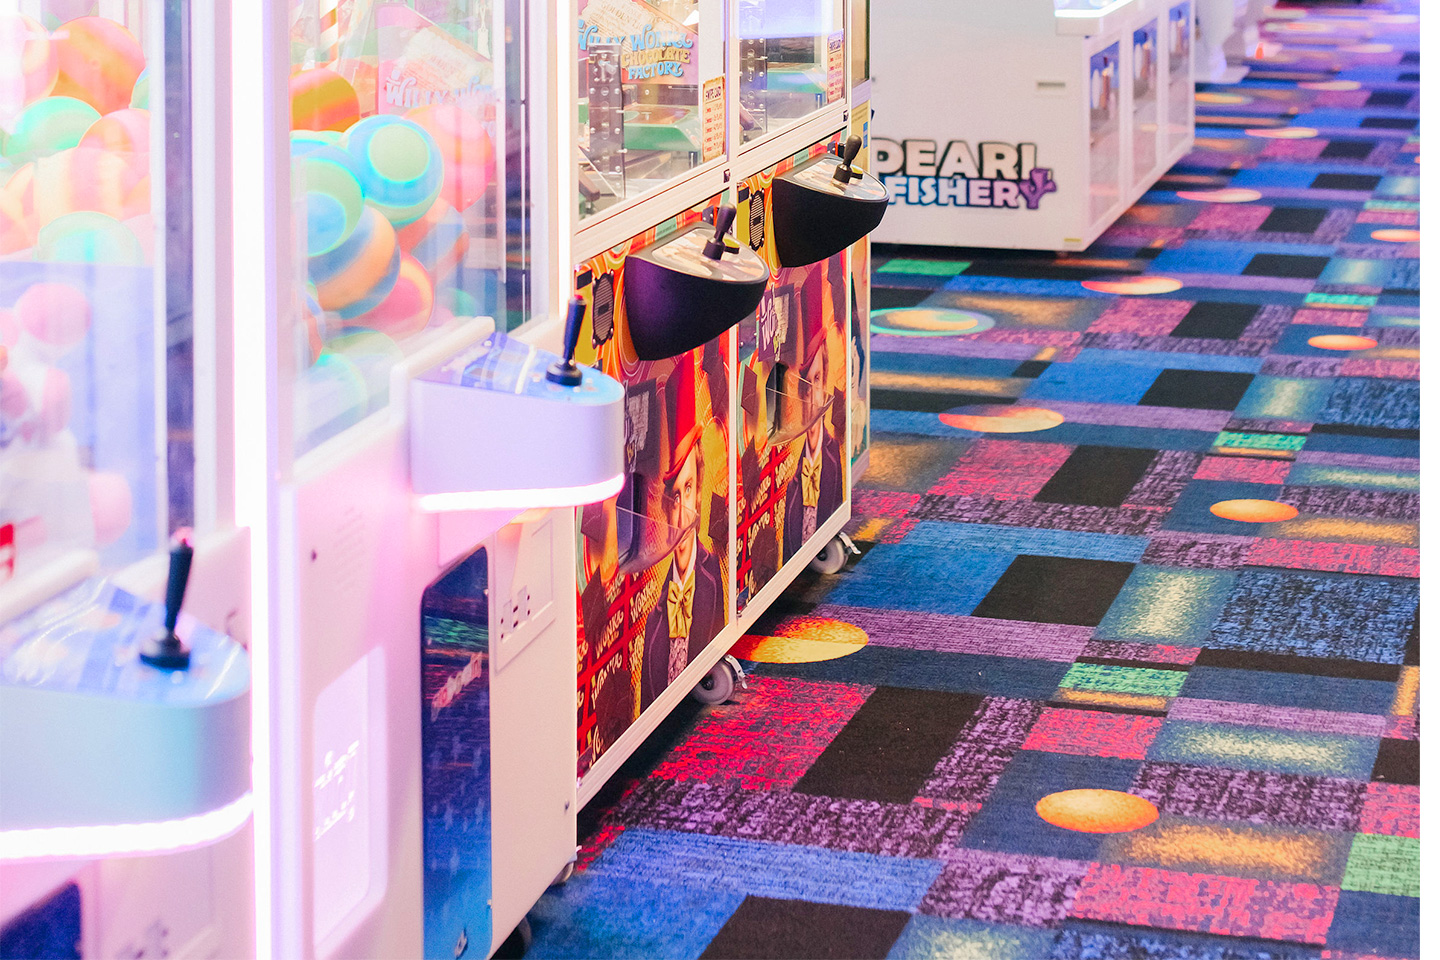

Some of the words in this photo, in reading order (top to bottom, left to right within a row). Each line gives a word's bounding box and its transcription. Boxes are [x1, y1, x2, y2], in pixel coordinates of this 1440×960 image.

[630, 24, 694, 52] WONKA
[621, 47, 691, 70] CHOCOLATE
[628, 61, 684, 80] FACTORY
[872, 138, 1053, 181] PEARL
[884, 168, 1058, 210] FISHERY
